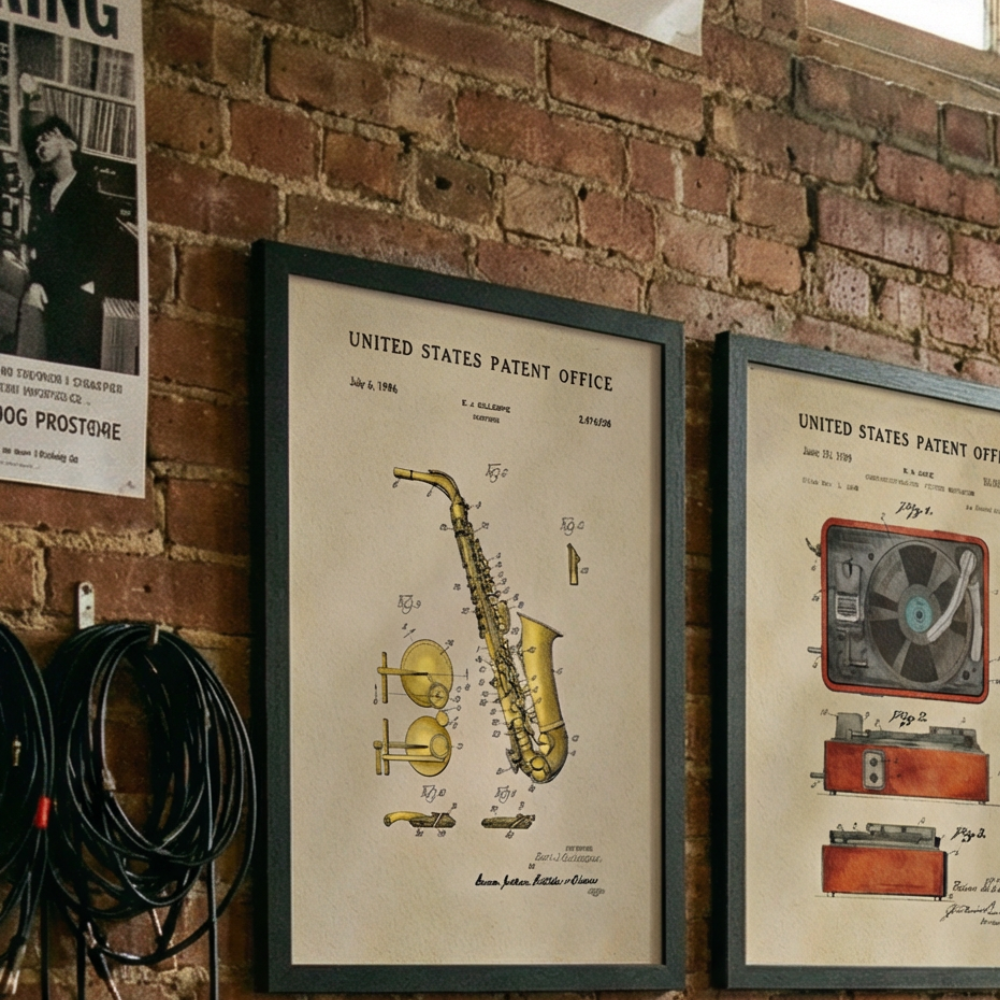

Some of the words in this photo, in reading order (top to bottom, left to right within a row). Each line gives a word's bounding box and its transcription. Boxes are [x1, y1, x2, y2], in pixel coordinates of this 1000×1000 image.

[348, 331, 413, 356] UNITED
[421, 343, 482, 368] STATES
[490, 355, 550, 380] PATENT
[558, 368, 613, 392] OFFICE
[0, 404, 28, 427] OG
[798, 413, 853, 436] UNITED
[859, 425, 909, 446] STATES
[916, 435, 967, 457] PATENT
